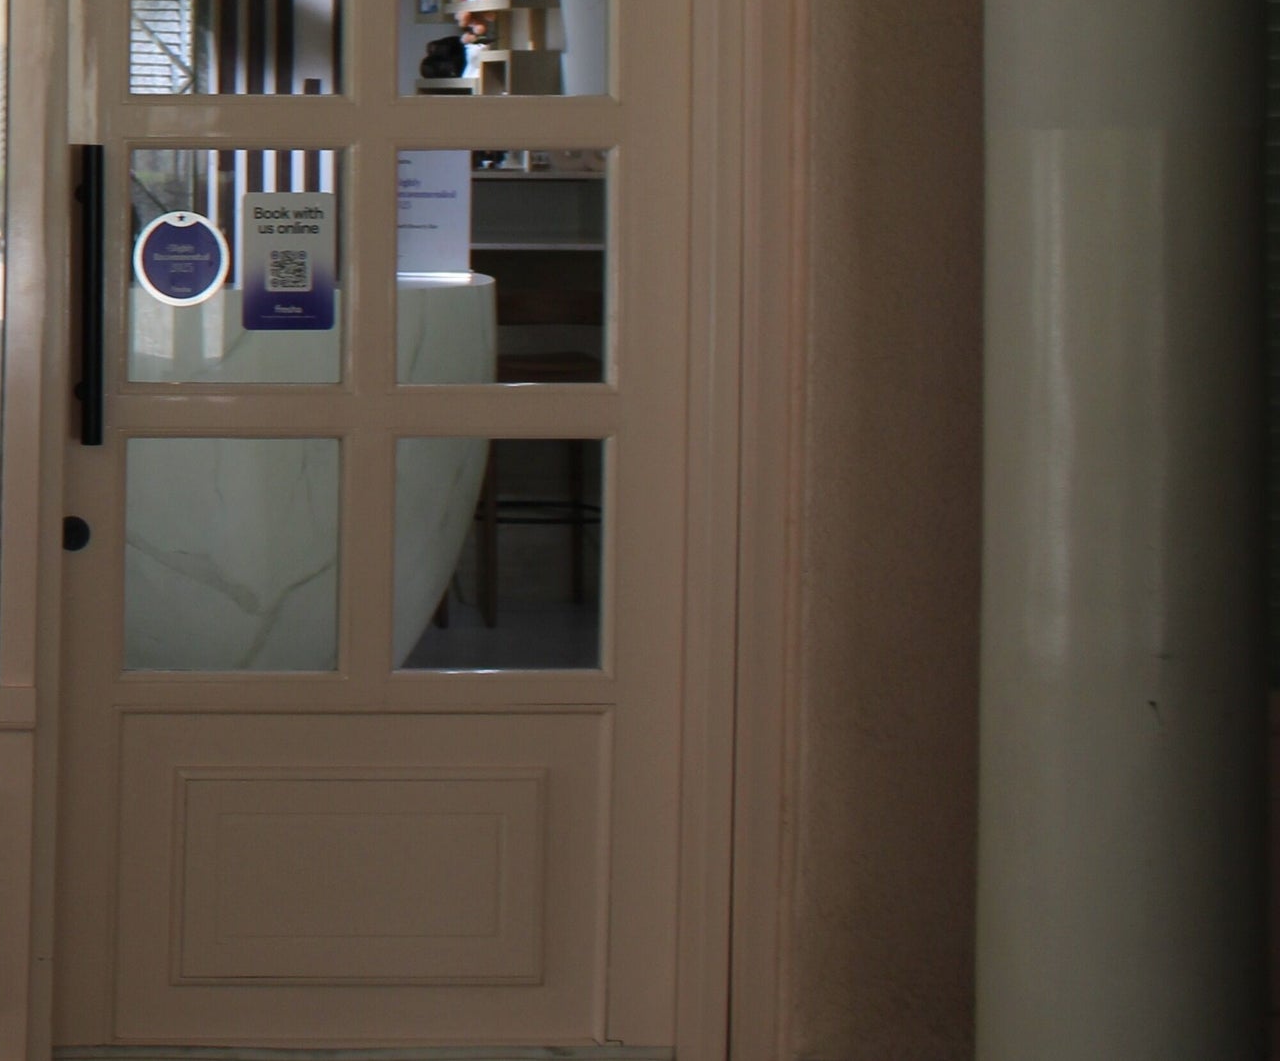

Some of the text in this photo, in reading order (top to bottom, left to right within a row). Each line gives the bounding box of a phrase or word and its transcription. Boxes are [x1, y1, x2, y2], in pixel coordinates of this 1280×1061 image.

[253, 206, 324, 220] Book with
[257, 222, 320, 235] us online
